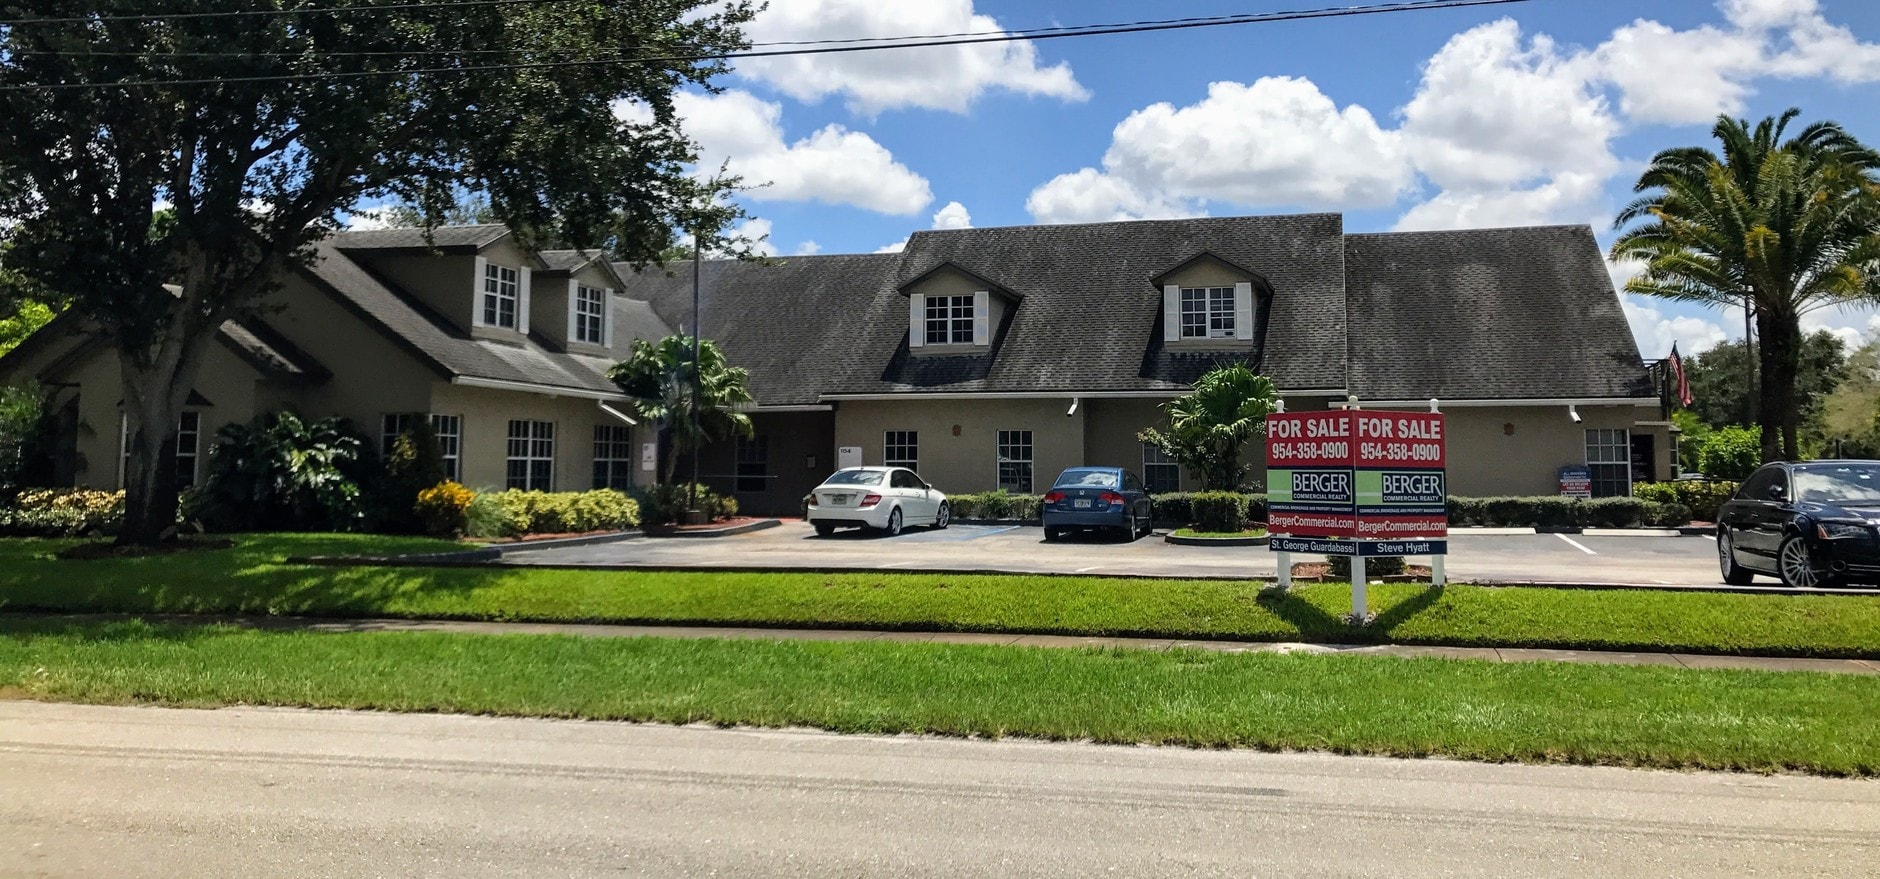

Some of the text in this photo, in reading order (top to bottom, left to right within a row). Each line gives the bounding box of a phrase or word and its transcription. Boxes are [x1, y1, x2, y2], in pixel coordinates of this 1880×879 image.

[1268, 417, 1350, 438] FOR SALE
[1358, 418, 1441, 439] FOR SALE
[1272, 441, 1349, 460] 954-358-0900
[1360, 442, 1440, 461] 954-358-0900
[1292, 473, 1350, 495] BERGER
[1383, 475, 1442, 497] BERGER
[1269, 514, 1355, 529] BergerCommercial.com
[1358, 520, 1447, 534] BergerCommercial.com
[1271, 539, 1355, 553] St. George Guardabassi
[1377, 542, 1430, 554] Steve Hyatt
